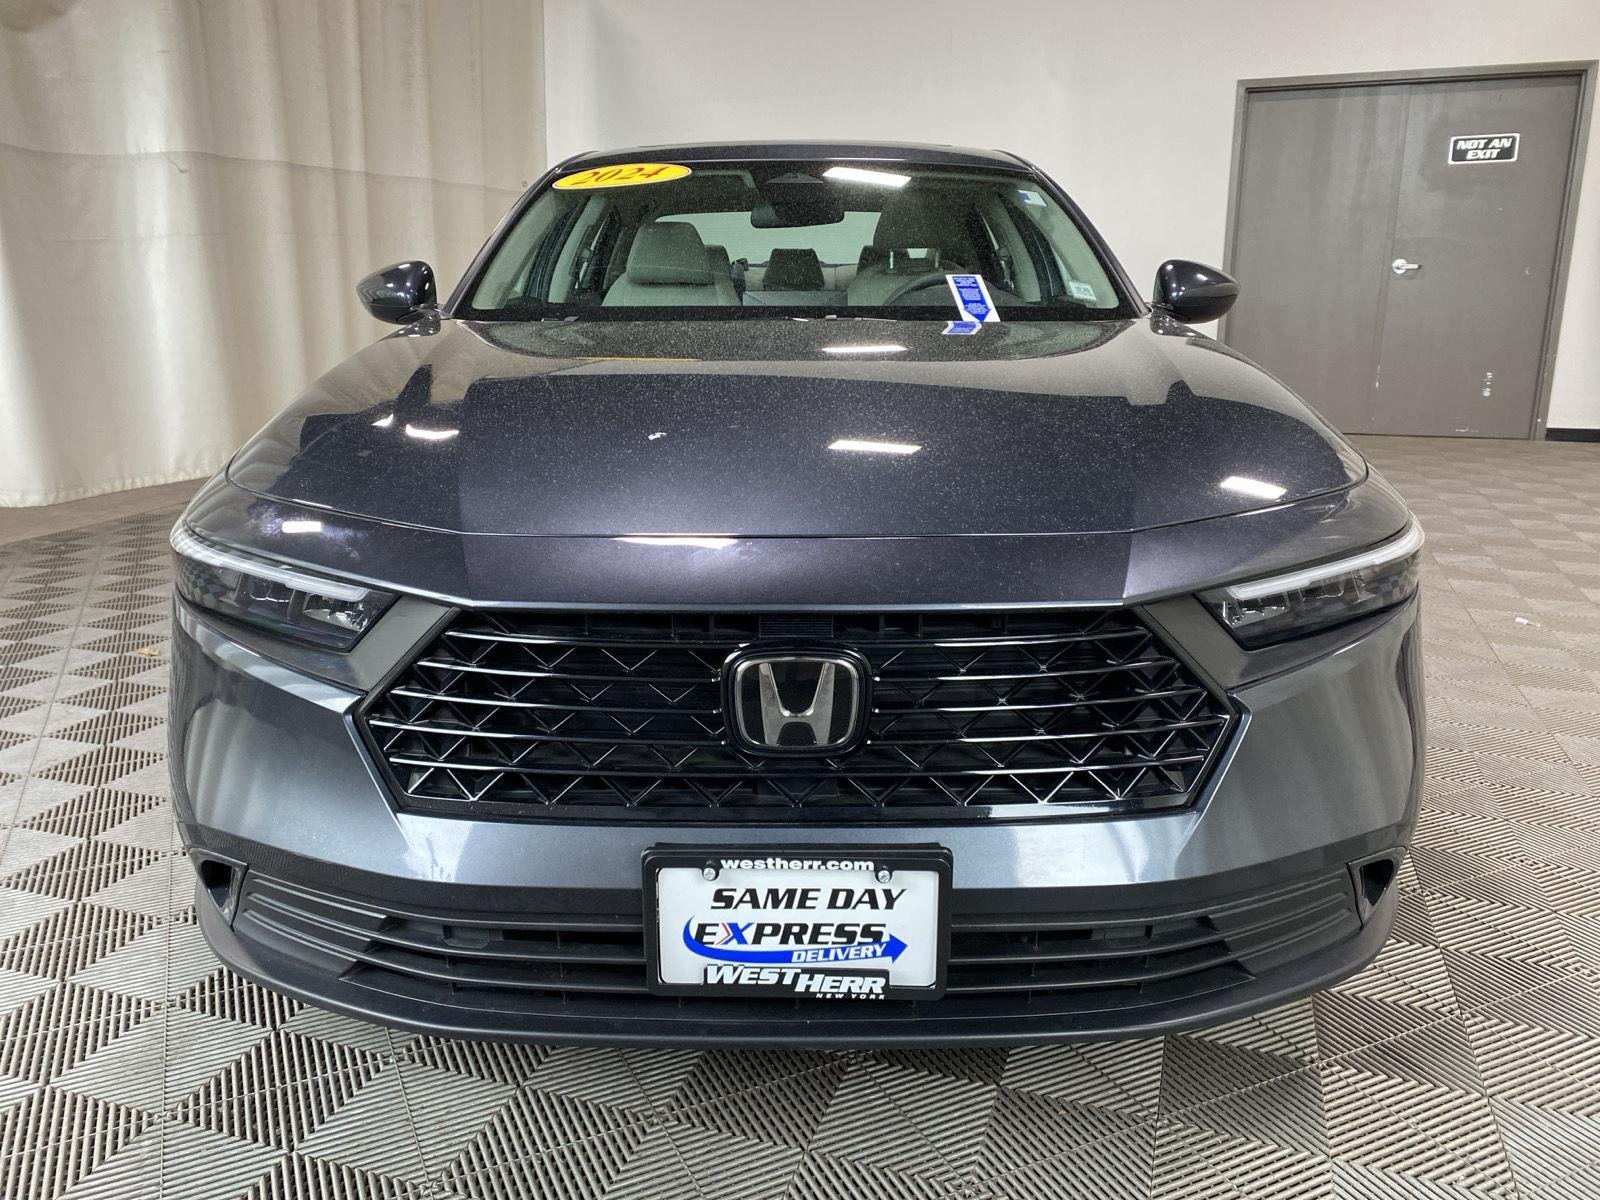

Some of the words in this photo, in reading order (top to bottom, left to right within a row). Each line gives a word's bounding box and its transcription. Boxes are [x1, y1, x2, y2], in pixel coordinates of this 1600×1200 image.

[1456, 139, 1489, 150] NOT
[1488, 138, 1513, 149] AN
[1466, 149, 1501, 160] EXIT
[571, 165, 671, 186] 2024
[720, 857, 875, 871] westherr.com
[710, 887, 821, 910] SAME
[826, 888, 908, 911] DAY
[693, 922, 887, 946] EXPRESS
[791, 942, 888, 963] DELIVERY
[850, 993, 886, 1001] YORK
